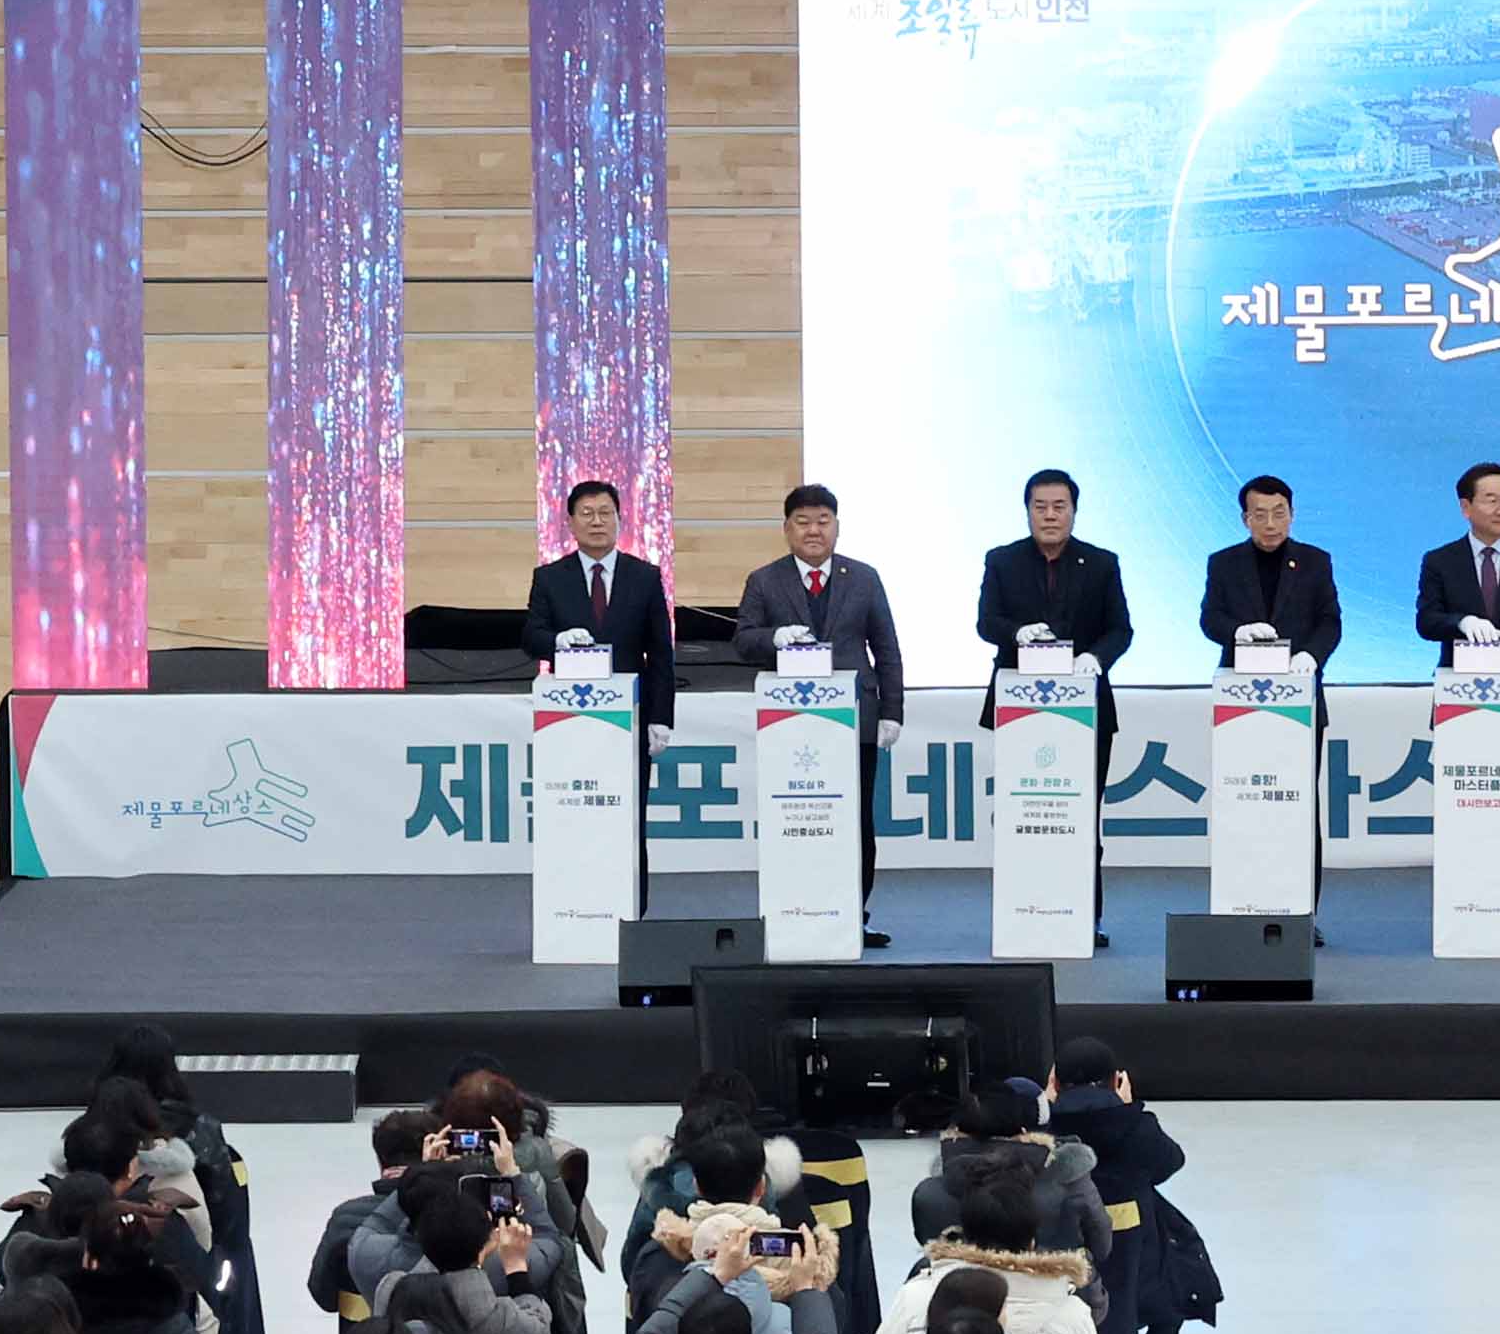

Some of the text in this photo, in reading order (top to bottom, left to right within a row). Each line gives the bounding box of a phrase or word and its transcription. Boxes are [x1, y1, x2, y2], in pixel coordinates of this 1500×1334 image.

[583, 794, 621, 806] 제물포!
[1261, 790, 1300, 802] 제물포!
[122, 790, 275, 829] 제물포르네상스
